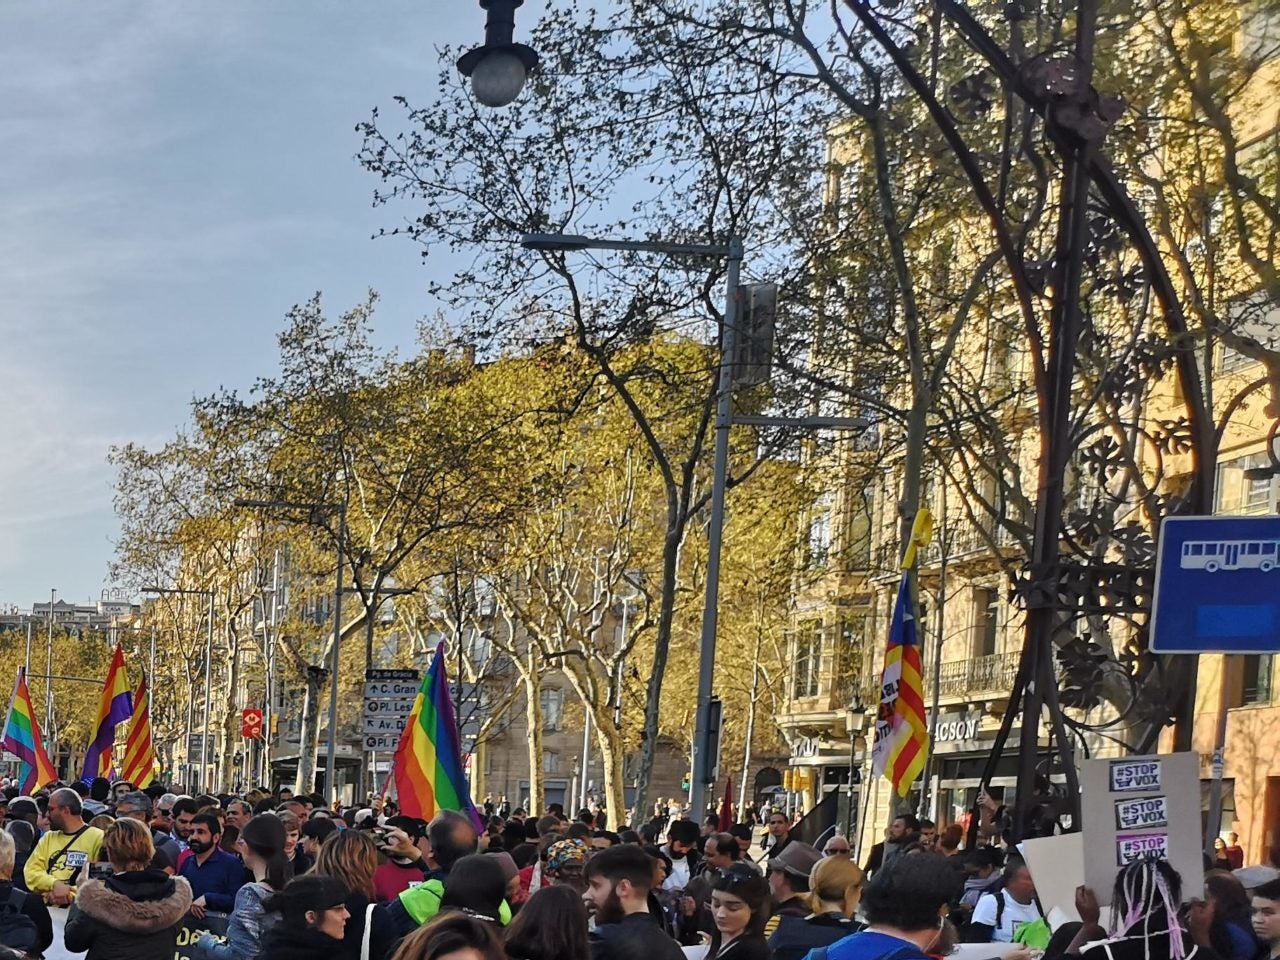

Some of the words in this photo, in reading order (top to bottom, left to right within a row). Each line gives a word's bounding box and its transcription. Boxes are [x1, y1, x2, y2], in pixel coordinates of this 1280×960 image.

[381, 684, 391, 693] C.
[394, 684, 416, 694] Gran
[380, 702, 391, 711] Pl.
[395, 703, 413, 712] Les
[379, 720, 393, 729] Av.
[1117, 764, 1158, 776] #STOP
[1134, 774, 1159, 786] VOX
[1122, 800, 1163, 814] #STOP
[1140, 810, 1166, 823] VOX
[1125, 838, 1165, 851] #STOP
